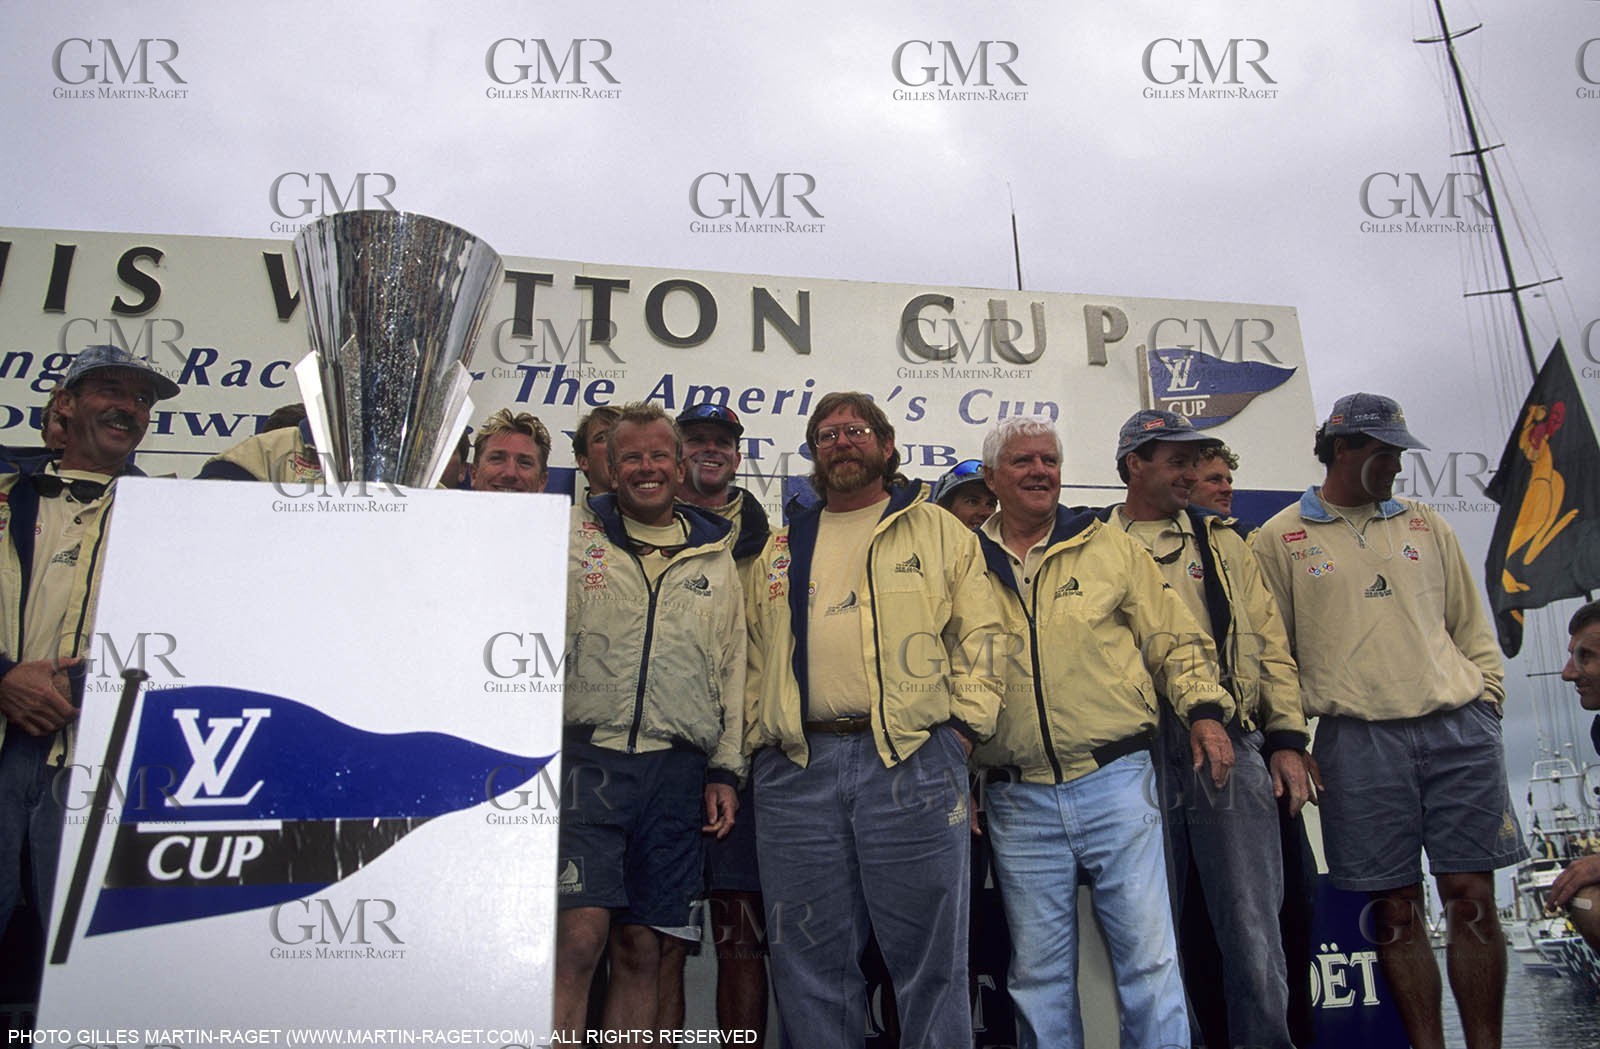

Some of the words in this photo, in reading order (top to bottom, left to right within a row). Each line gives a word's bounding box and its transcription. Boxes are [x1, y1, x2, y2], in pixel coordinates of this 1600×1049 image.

[901, 293, 1129, 366] CUP
[514, 364, 615, 406] The
[1167, 400, 1207, 418] CUP
[146, 835, 265, 881] CUP
